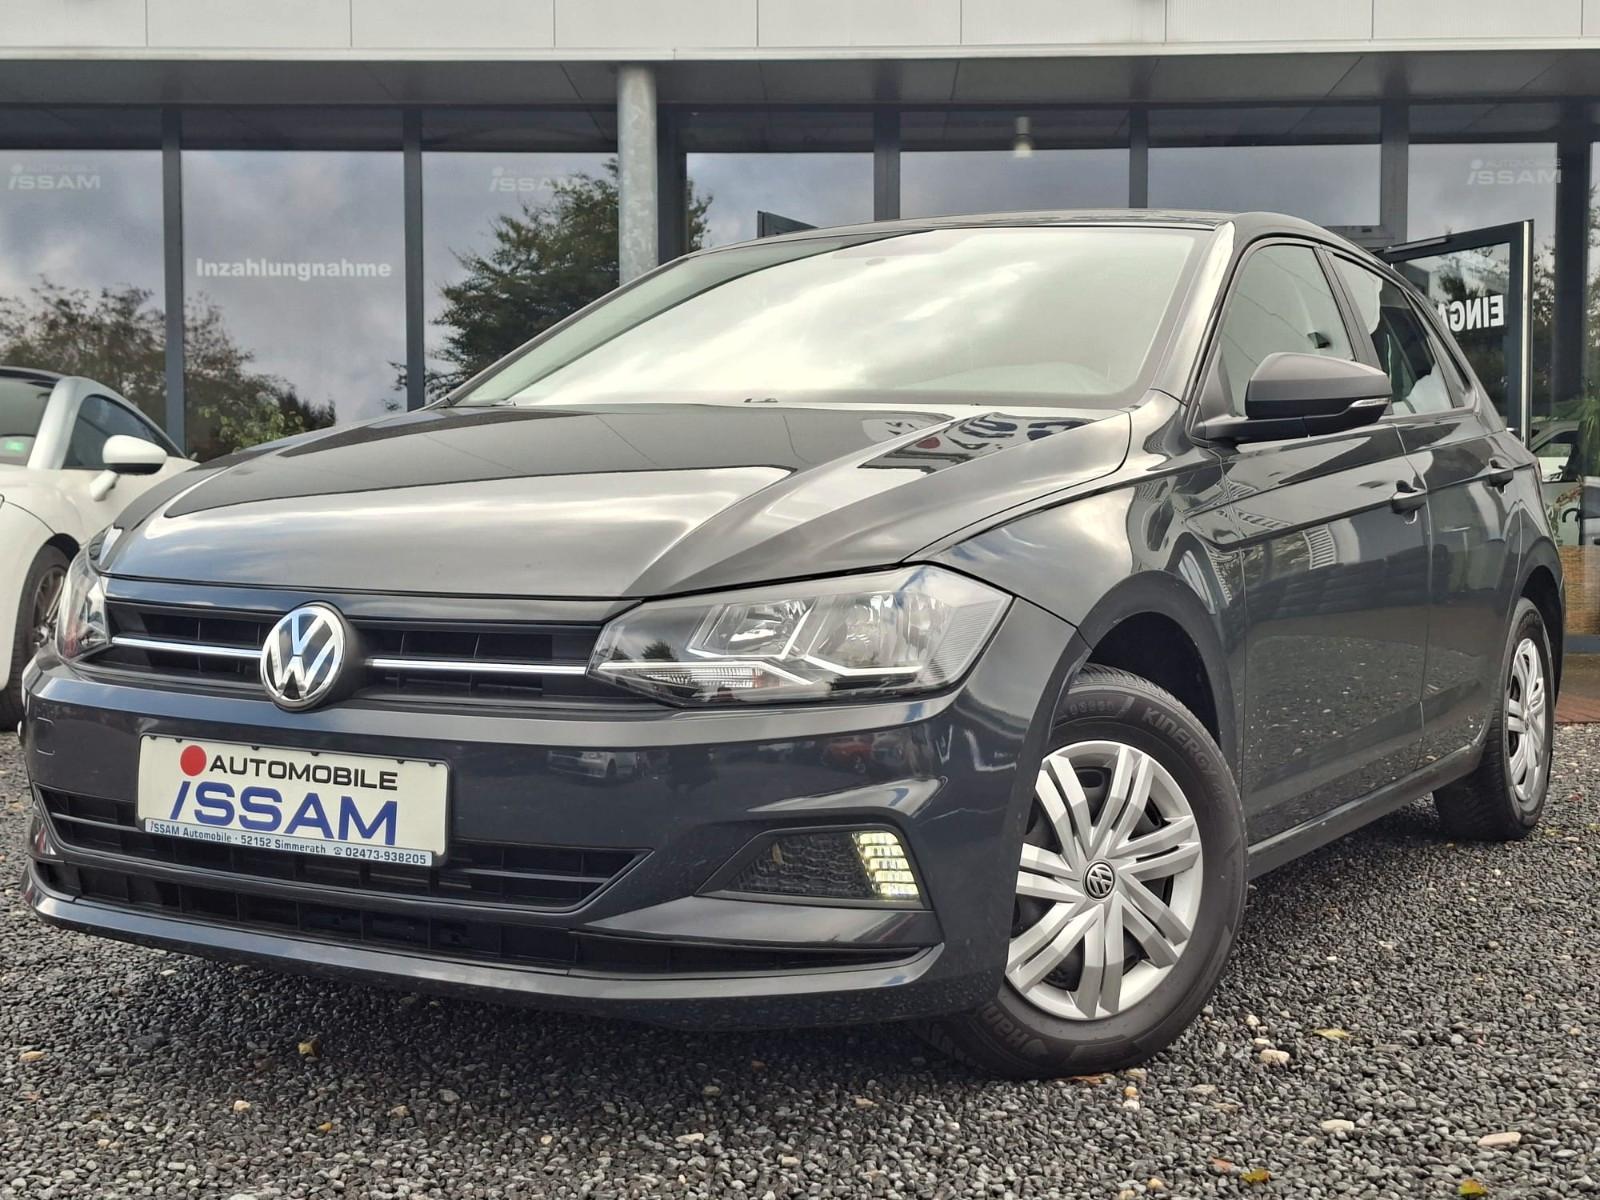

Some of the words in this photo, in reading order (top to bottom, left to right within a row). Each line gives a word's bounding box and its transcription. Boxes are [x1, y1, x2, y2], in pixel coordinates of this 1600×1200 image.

[196, 258, 391, 281] Inzahlungnahme
[209, 754, 398, 791] AUTOMOBILE
[183, 827, 232, 843] Automobile
[241, 835, 272, 847] 52152
[275, 839, 326, 854] Simmerath
[345, 847, 426, 865] 02473-938205
